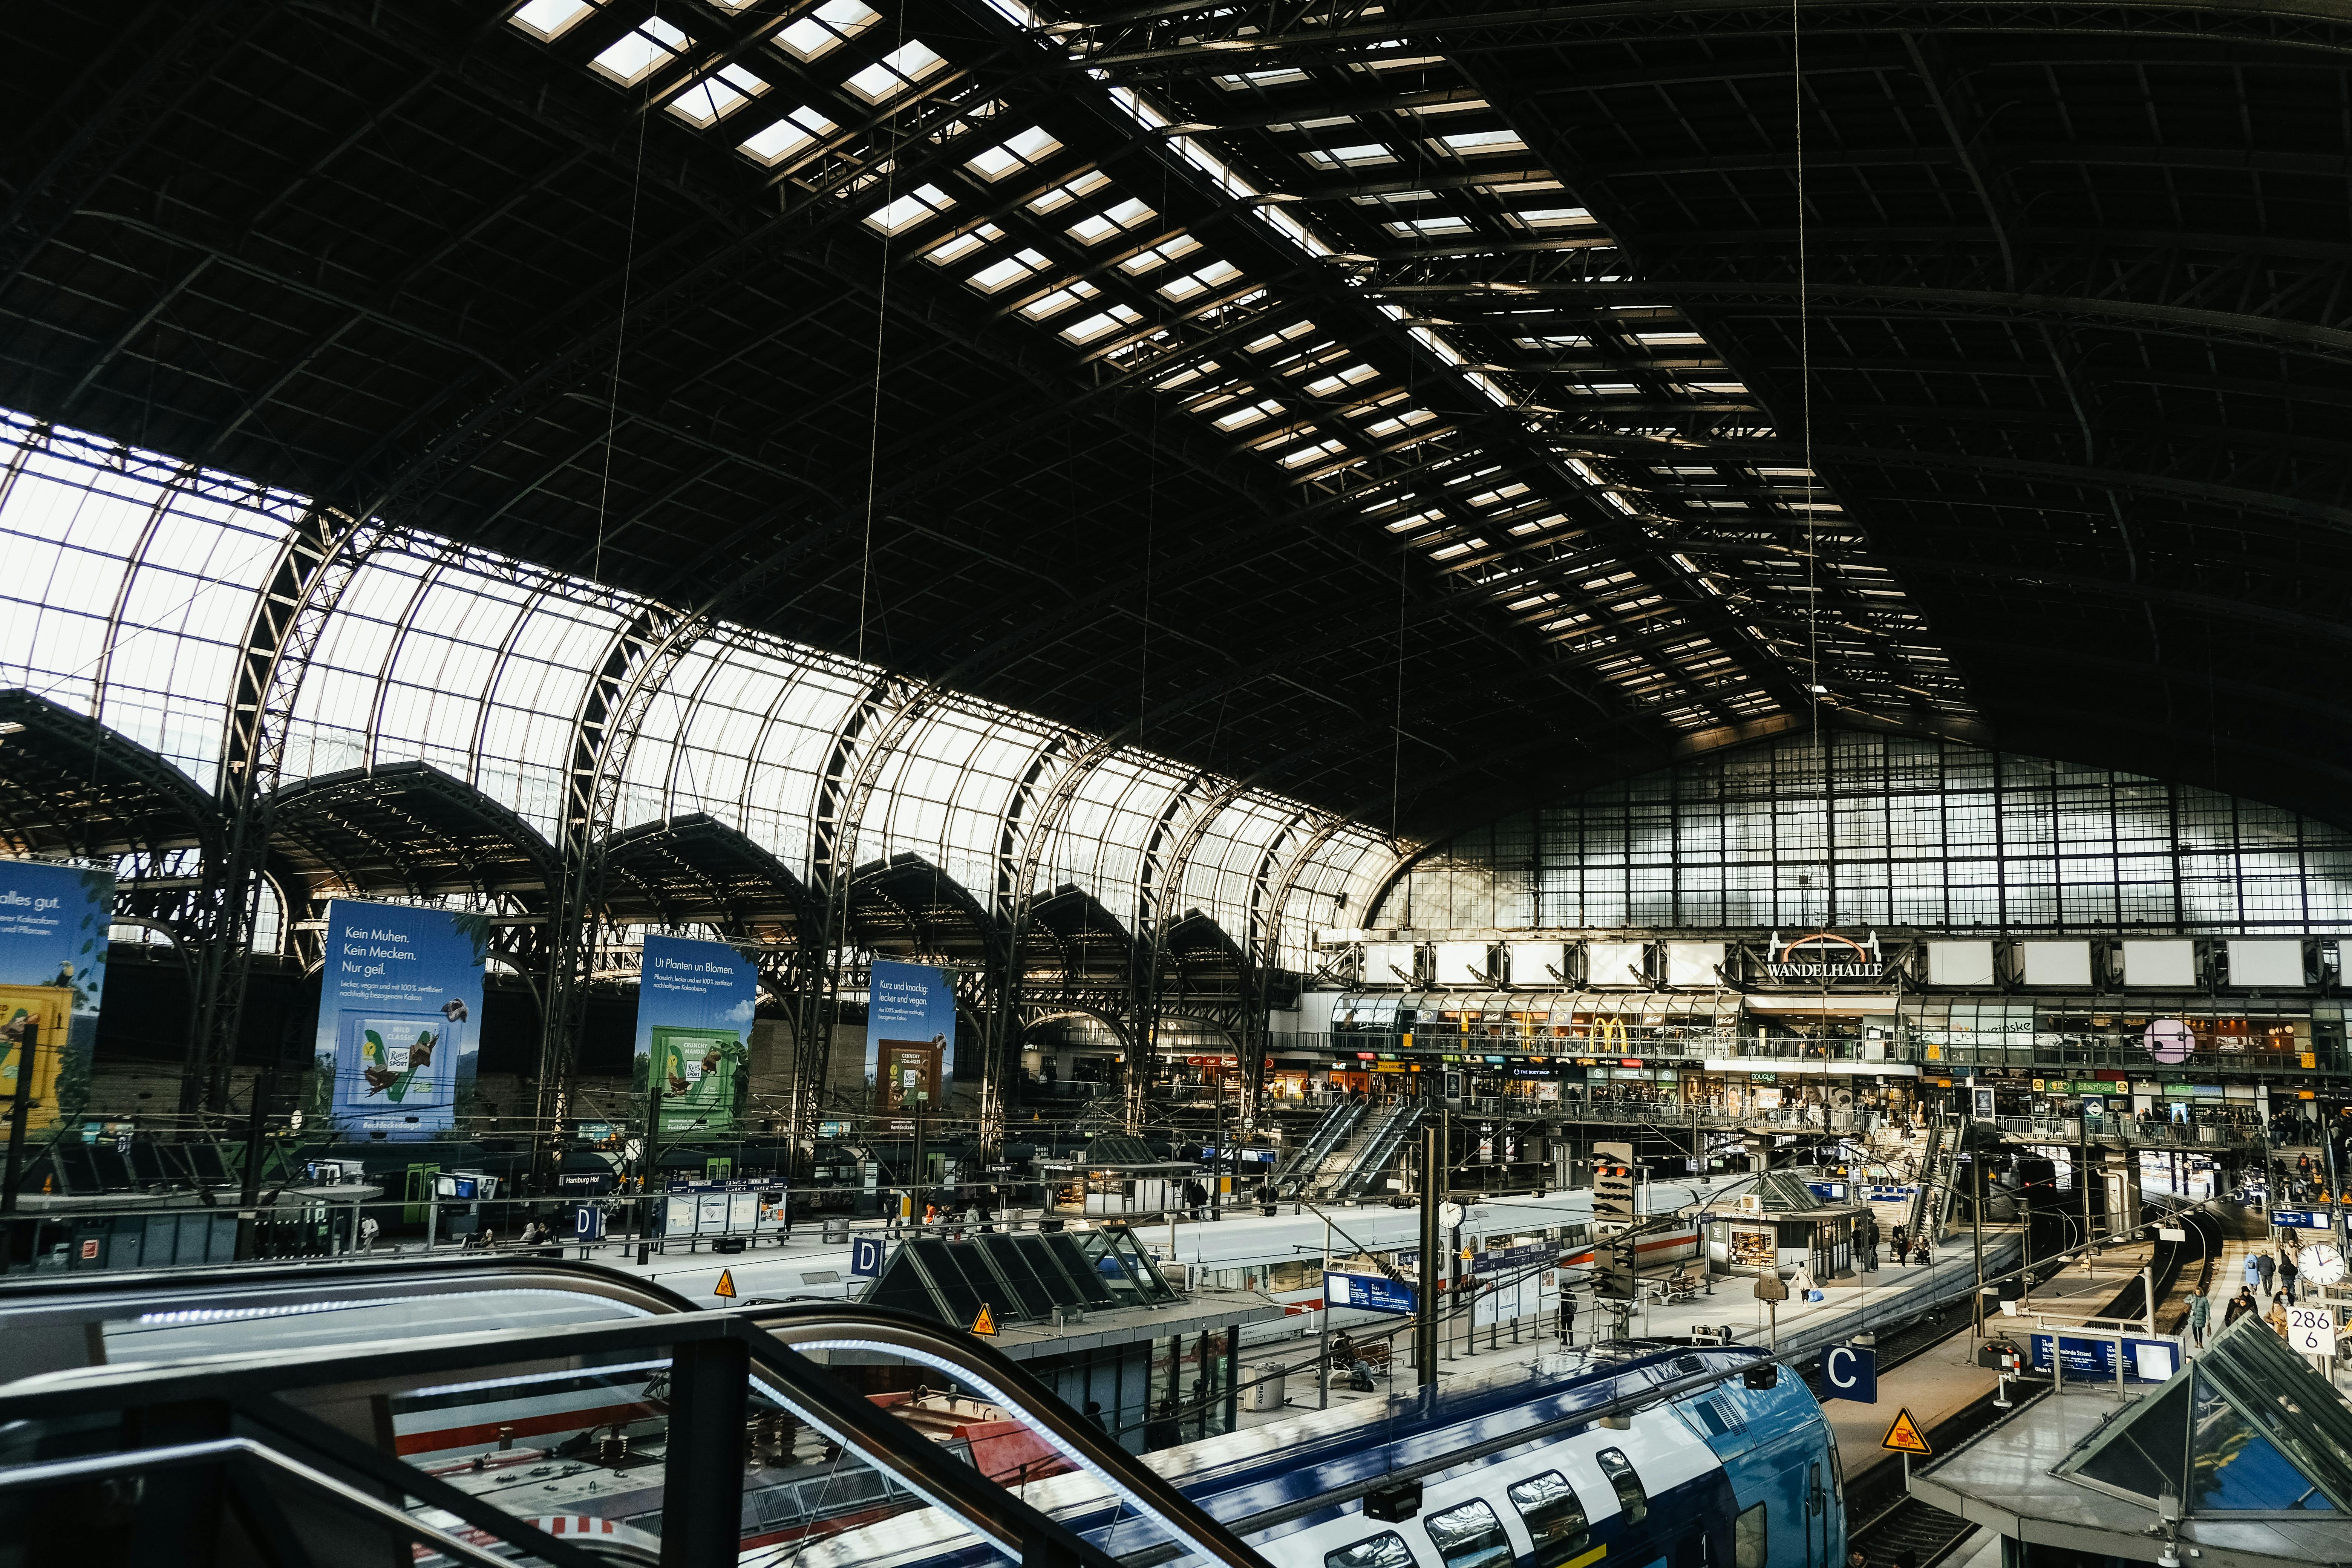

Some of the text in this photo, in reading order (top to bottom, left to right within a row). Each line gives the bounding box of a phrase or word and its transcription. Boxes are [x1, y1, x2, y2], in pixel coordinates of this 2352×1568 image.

[34, 897, 61, 911] gut.
[345, 926, 409, 943] Kein Muhen.
[343, 943, 416, 960] Kein Meckern.
[342, 960, 386, 977] Nur geil.
[655, 957, 664, 967] Ut
[666, 958, 692, 971] Planten
[706, 962, 734, 974] Blomen.
[1766, 964, 1883, 977] WANDELHALLE
[653, 982, 680, 991] nachhaltigem
[880, 979, 928, 995] Kurz und knackig:
[340, 990, 369, 999] nachhaltig
[370, 992, 403, 1000] bezogenem
[879, 992, 927, 1007] lecker und vegan.
[2078, 1083, 2114, 1091] bierbar
[1225, 1132, 1229, 1141] E
[1691, 1159, 1697, 1169] E
[577, 1209, 589, 1233] D
[860, 1242, 875, 1270] D
[2291, 1310, 2329, 1329] 286
[2306, 1332, 2317, 1348] 6
[1828, 1348, 1856, 1388] C
[1702, 1535, 1706, 1560] 1
